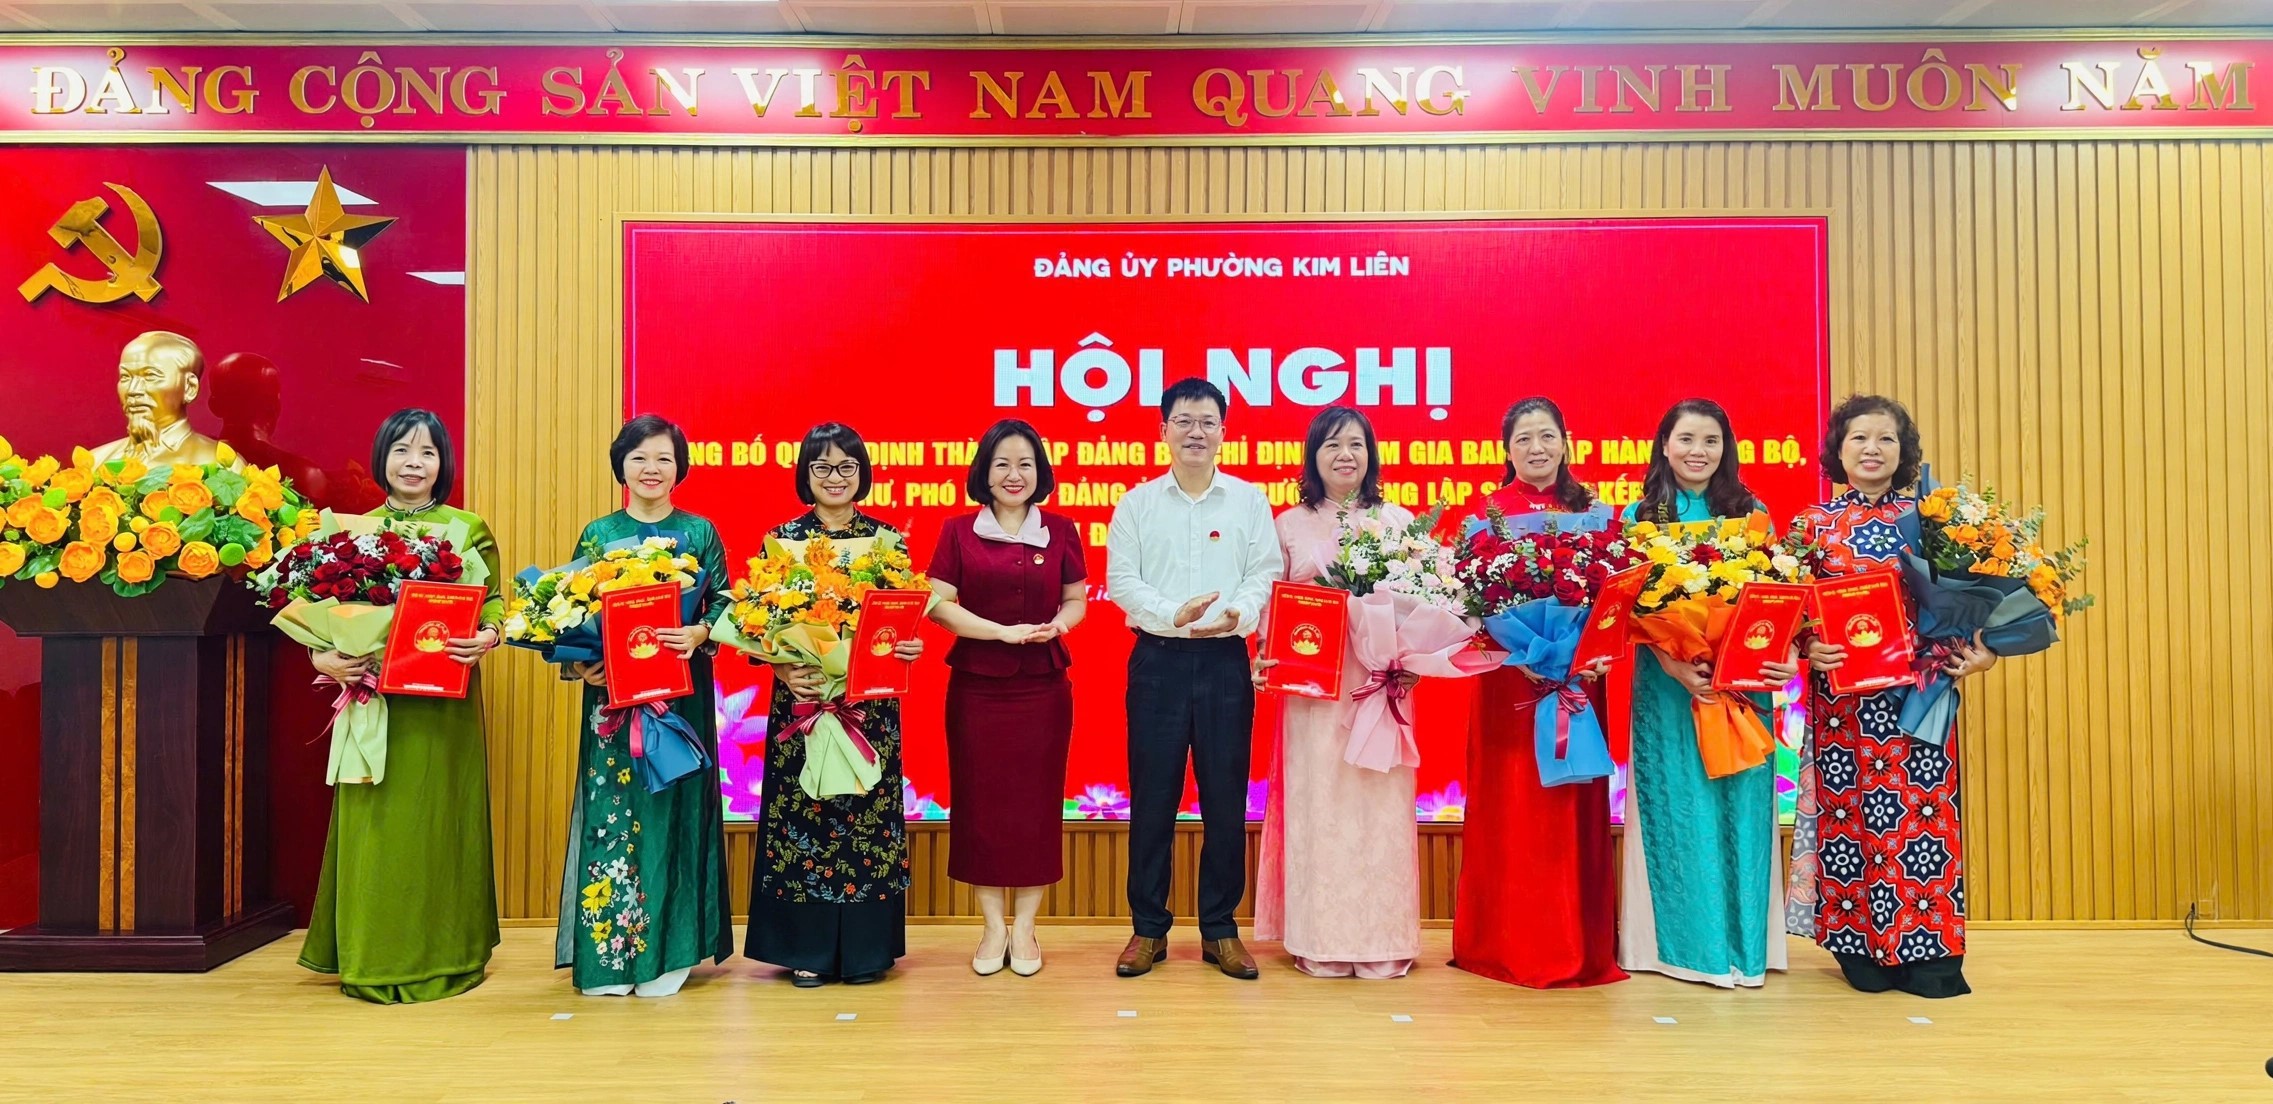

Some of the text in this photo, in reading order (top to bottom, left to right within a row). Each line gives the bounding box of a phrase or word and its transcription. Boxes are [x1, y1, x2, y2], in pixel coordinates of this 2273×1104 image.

[30, 46, 2256, 132] ĐẢNG CỘNG SẢN VIỆT NAM QUANG VINH MUÔN NĂM
[1033, 250, 1410, 278] ĐẢNG ỦY PHƯỜNG KIM LIÊN
[994, 331, 1452, 422] HỘI NGHỊ
[731, 433, 767, 466] BỐ
[1077, 435, 1146, 466] ĐẢNG
[1256, 440, 1305, 470] ĐỊN
[1408, 440, 1454, 465] GIA
[1763, 434, 1807, 469] BỘ,
[905, 479, 956, 507] PHÓ
[1058, 476, 1127, 506] ĐẢNG
[1427, 476, 1473, 510] LẬP
